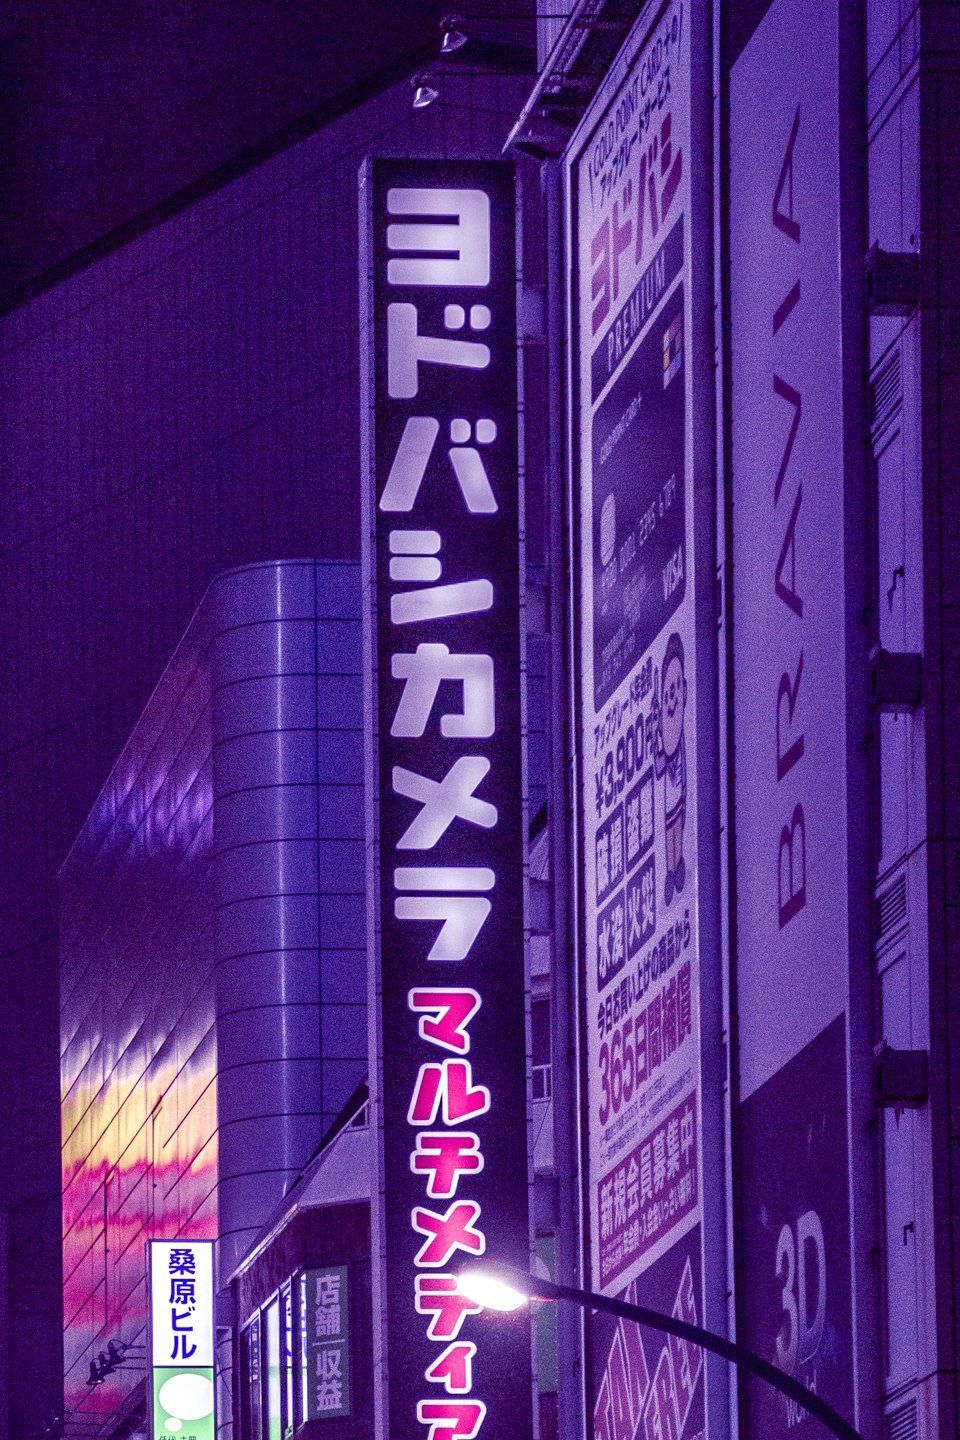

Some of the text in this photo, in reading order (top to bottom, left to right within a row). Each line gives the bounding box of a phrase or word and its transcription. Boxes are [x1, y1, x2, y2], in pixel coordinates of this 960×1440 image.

[591, 111, 683, 337] ヨドバシ
[594, 119, 615, 178] GOLD
[607, 249, 666, 373] PREMIUM
[379, 187, 499, 962] ヨドバシカメラ
[772, 103, 808, 931] BRAVIA
[168, 1247, 197, 1361] 桑原ビル
[775, 1210, 827, 1374] 3D
